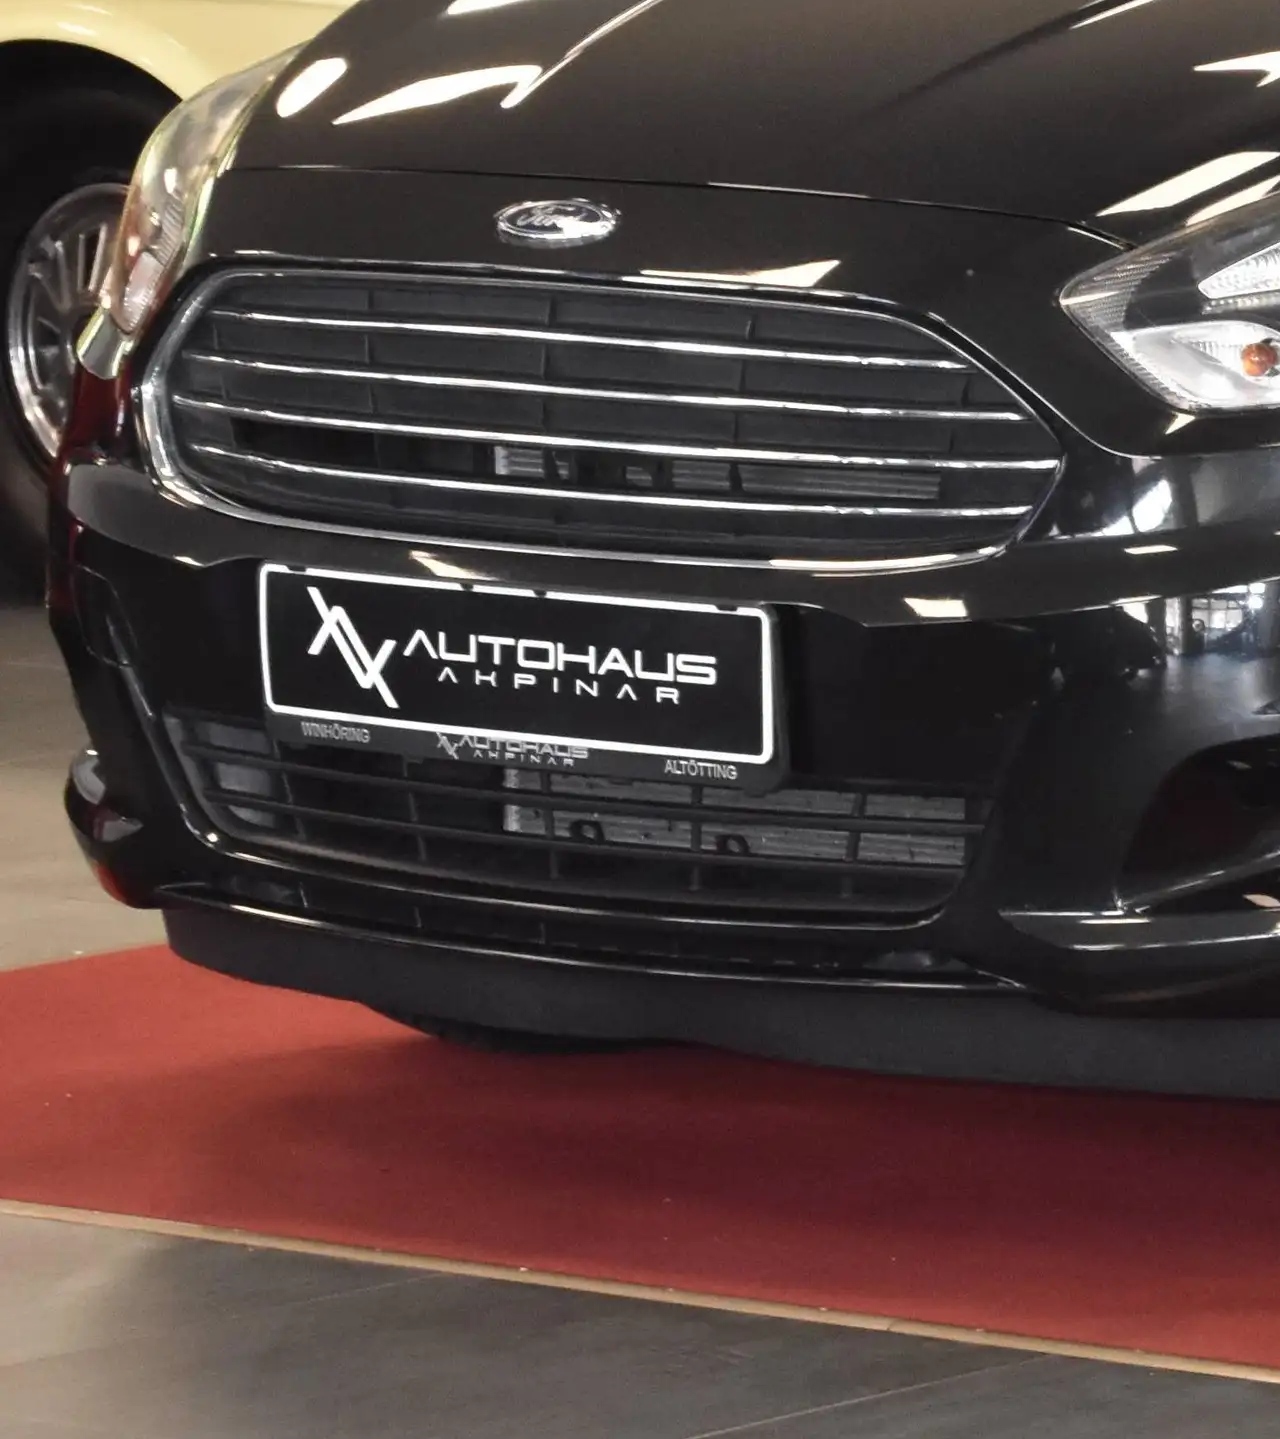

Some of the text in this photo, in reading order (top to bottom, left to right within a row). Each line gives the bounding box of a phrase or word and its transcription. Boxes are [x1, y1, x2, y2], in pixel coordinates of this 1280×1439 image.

[403, 628, 716, 685] AUTOHAUS
[438, 666, 680, 704] AKPINAR
[301, 721, 370, 744] WINHÖRING
[459, 734, 589, 759] AUTOHAUS
[664, 758, 738, 780] ALTÖTTING
